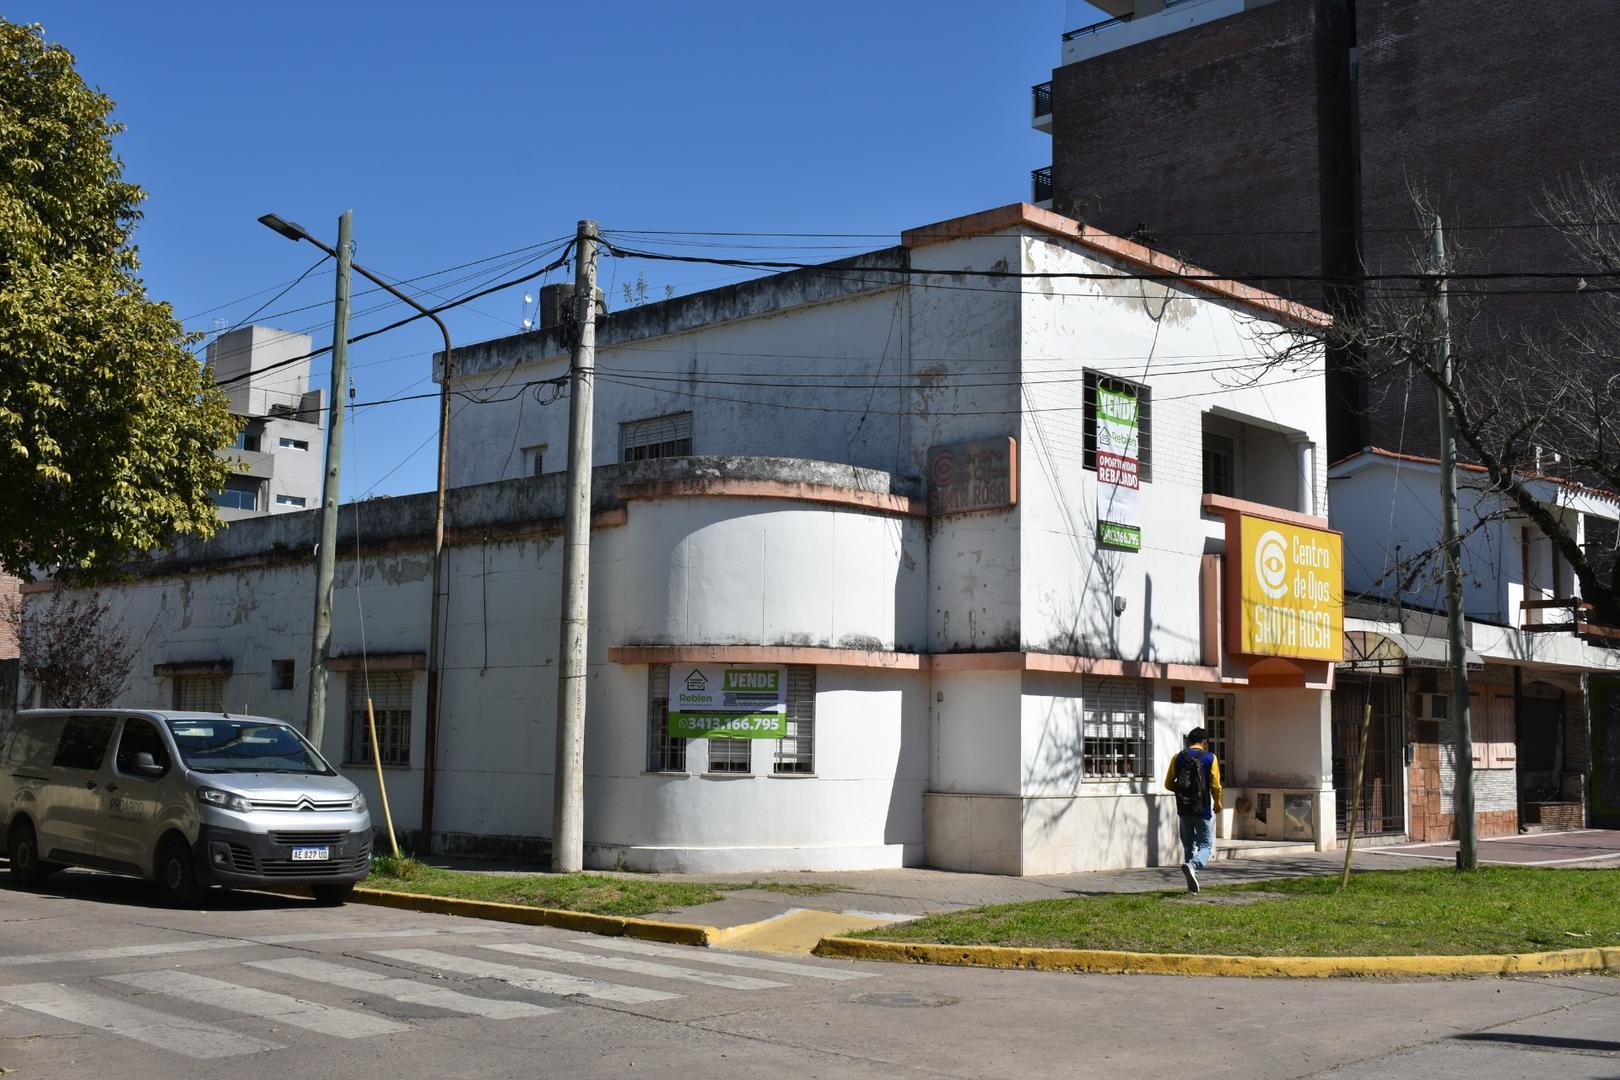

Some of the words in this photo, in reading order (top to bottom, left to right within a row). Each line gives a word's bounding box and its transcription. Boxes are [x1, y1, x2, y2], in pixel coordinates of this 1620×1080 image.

[1292, 534, 1330, 569] Centro
[1293, 568, 1307, 599] de
[1308, 570, 1330, 609] Ojos
[1254, 604, 1297, 646] SANTA
[1299, 608, 1331, 649] ROSA
[728, 672, 776, 688] VENDE
[679, 693, 713, 703] Rebien
[687, 717, 780, 730] 3413.166.795
